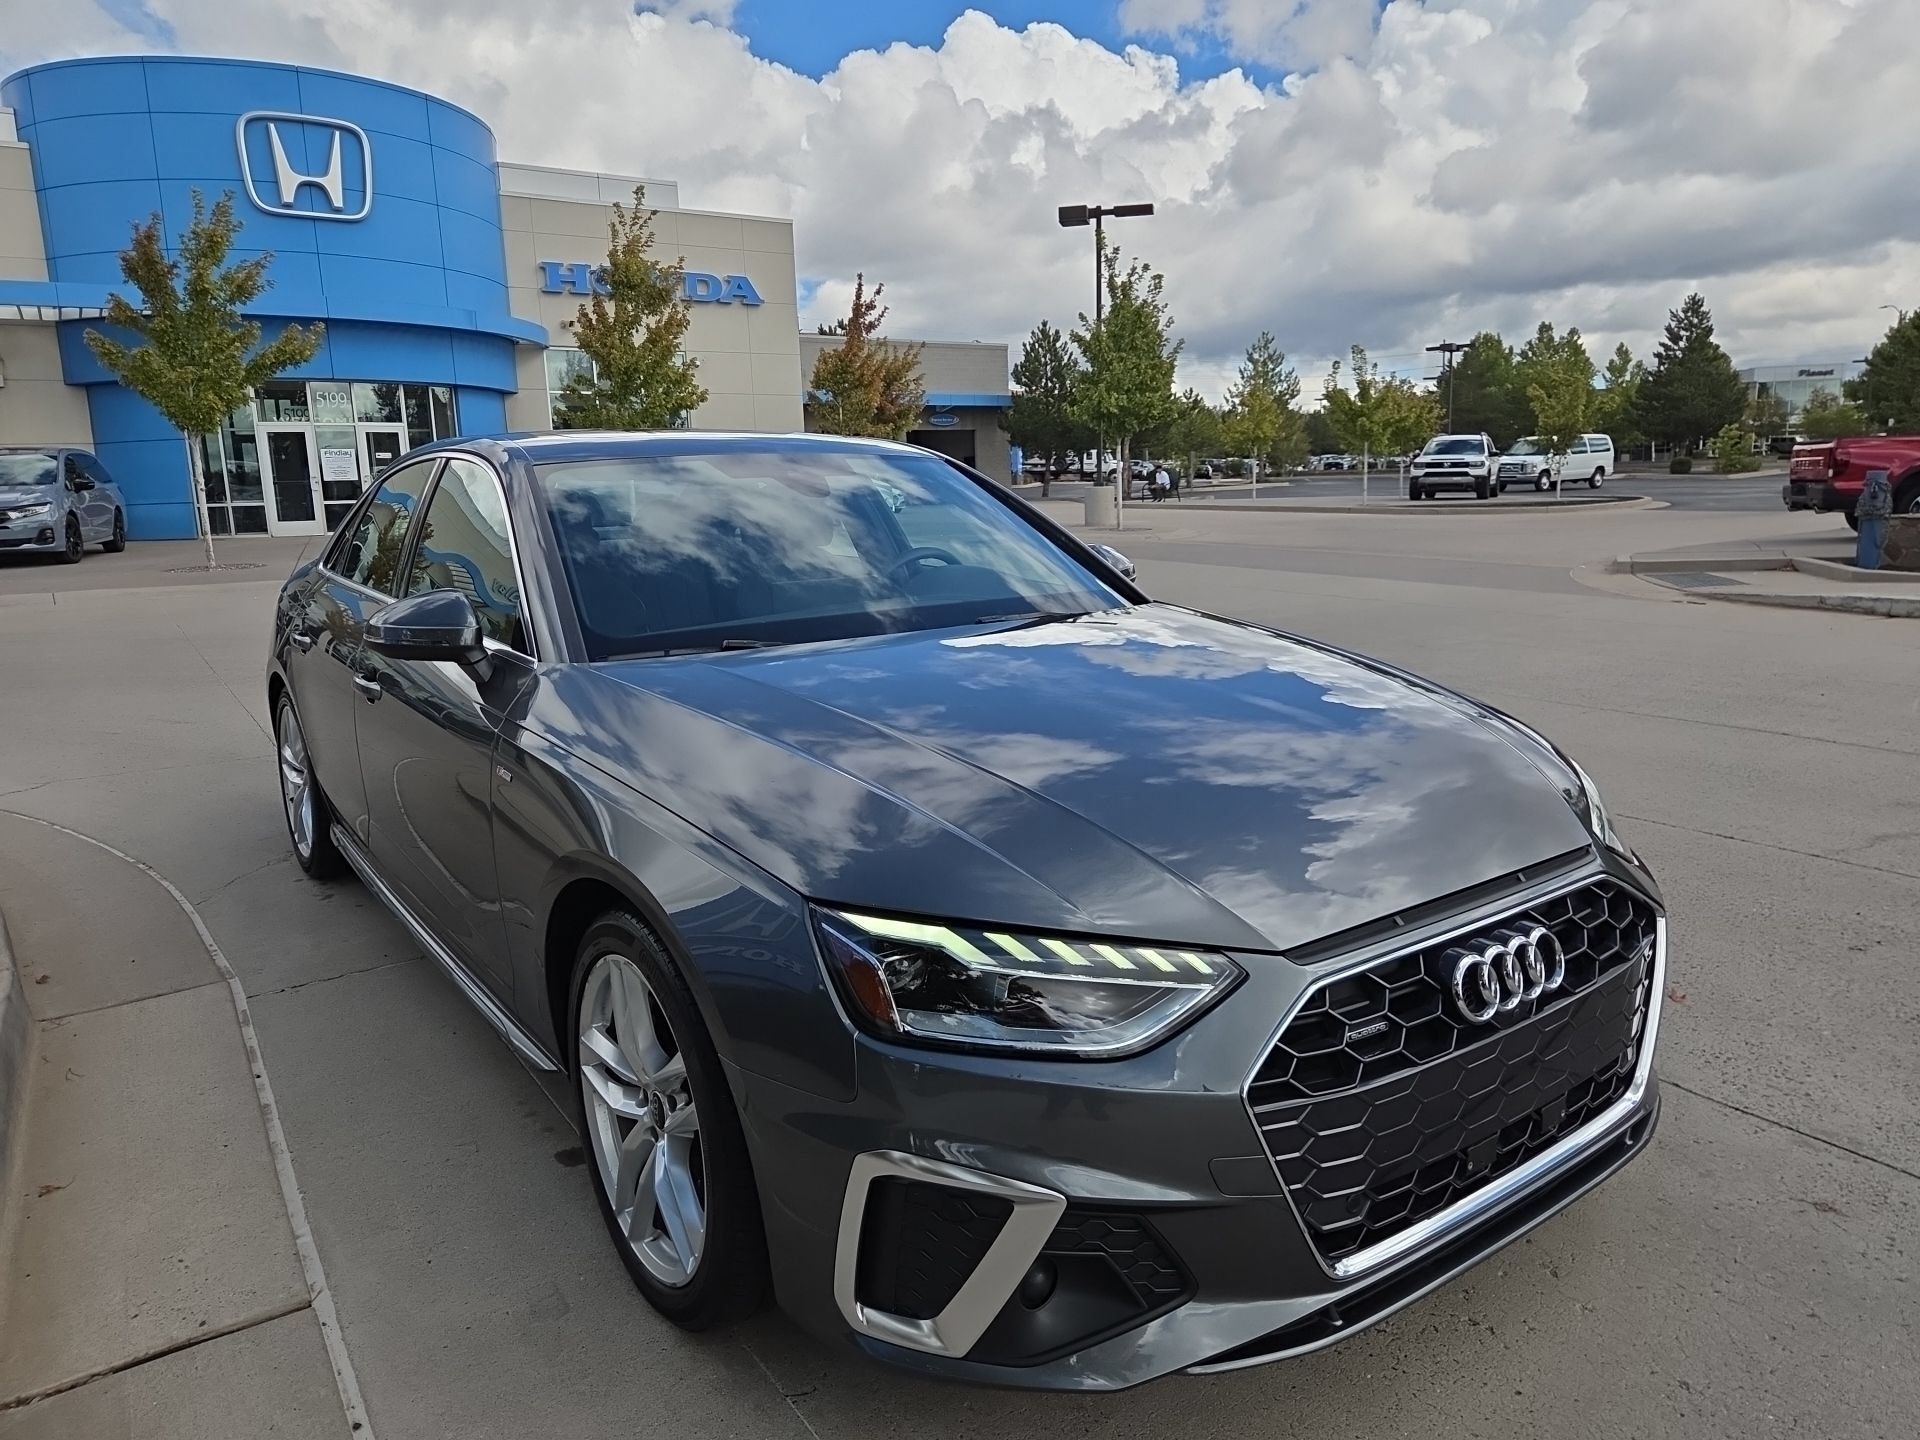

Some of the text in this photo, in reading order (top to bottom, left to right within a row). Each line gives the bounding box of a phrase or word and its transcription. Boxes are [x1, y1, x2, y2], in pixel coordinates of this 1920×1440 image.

[540, 261, 765, 305] HDA
[316, 392, 347, 408] 5199
[1350, 1025, 1387, 1039] quattro
